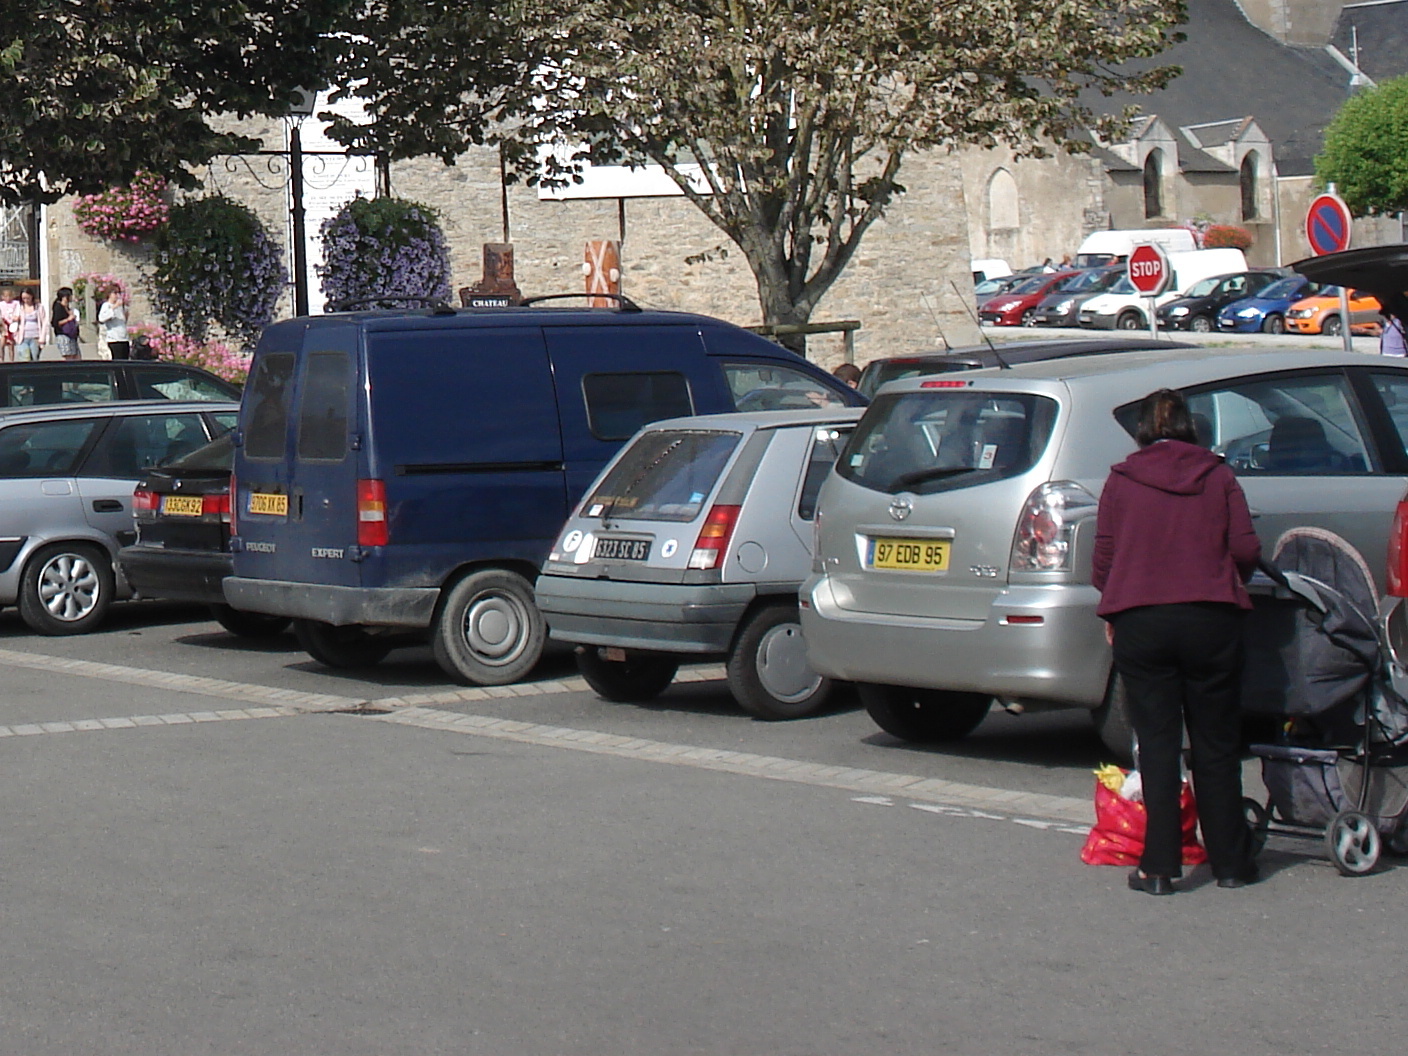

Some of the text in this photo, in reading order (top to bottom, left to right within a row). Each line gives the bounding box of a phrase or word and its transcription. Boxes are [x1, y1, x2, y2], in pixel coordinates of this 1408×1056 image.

[1132, 261, 1161, 277] STOP
[472, 299, 509, 307] CHATEAU
[246, 542, 276, 553] PEUGEOT
[311, 547, 344, 559] EXPERT
[595, 540, 619, 558] 6323
[618, 541, 632, 558] SC
[877, 544, 943, 565] 97 EDB 95
